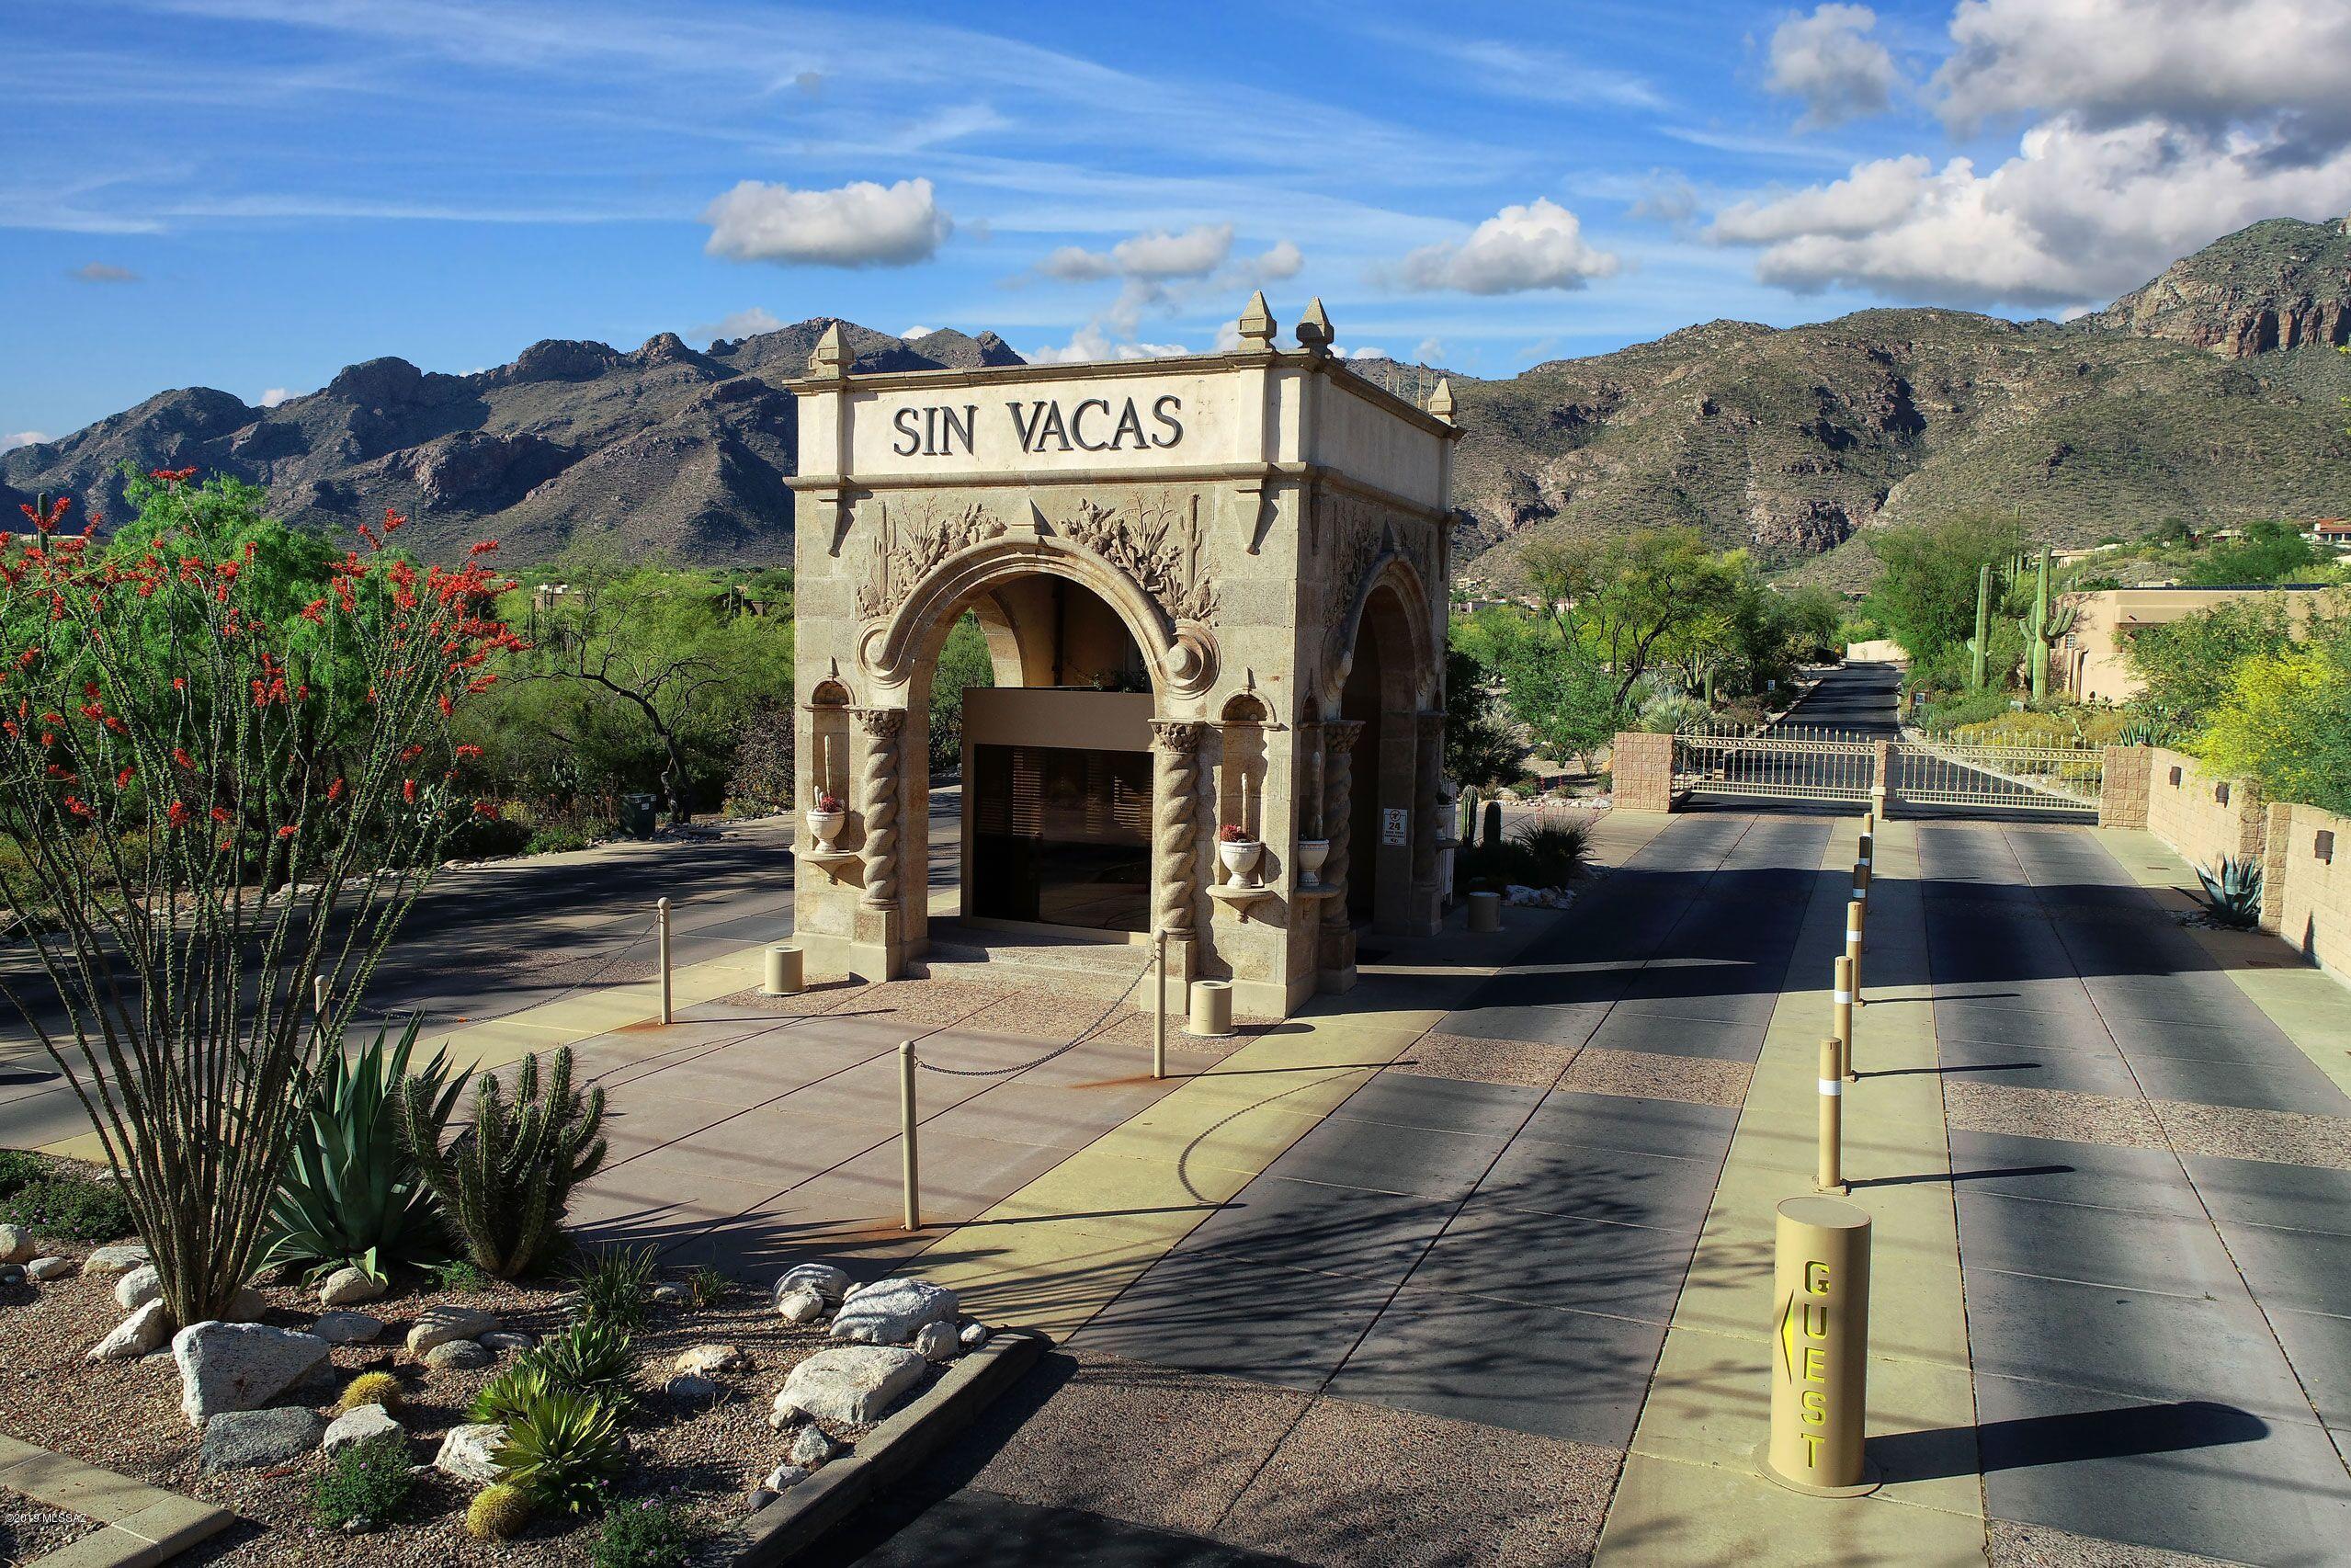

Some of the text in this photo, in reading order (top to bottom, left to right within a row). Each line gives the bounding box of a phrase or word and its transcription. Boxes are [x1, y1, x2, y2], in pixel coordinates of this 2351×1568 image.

[893, 395, 1184, 457] SIN VACAS
[1389, 822, 1401, 830] 24
[1800, 1260, 1830, 1469] GUEST
